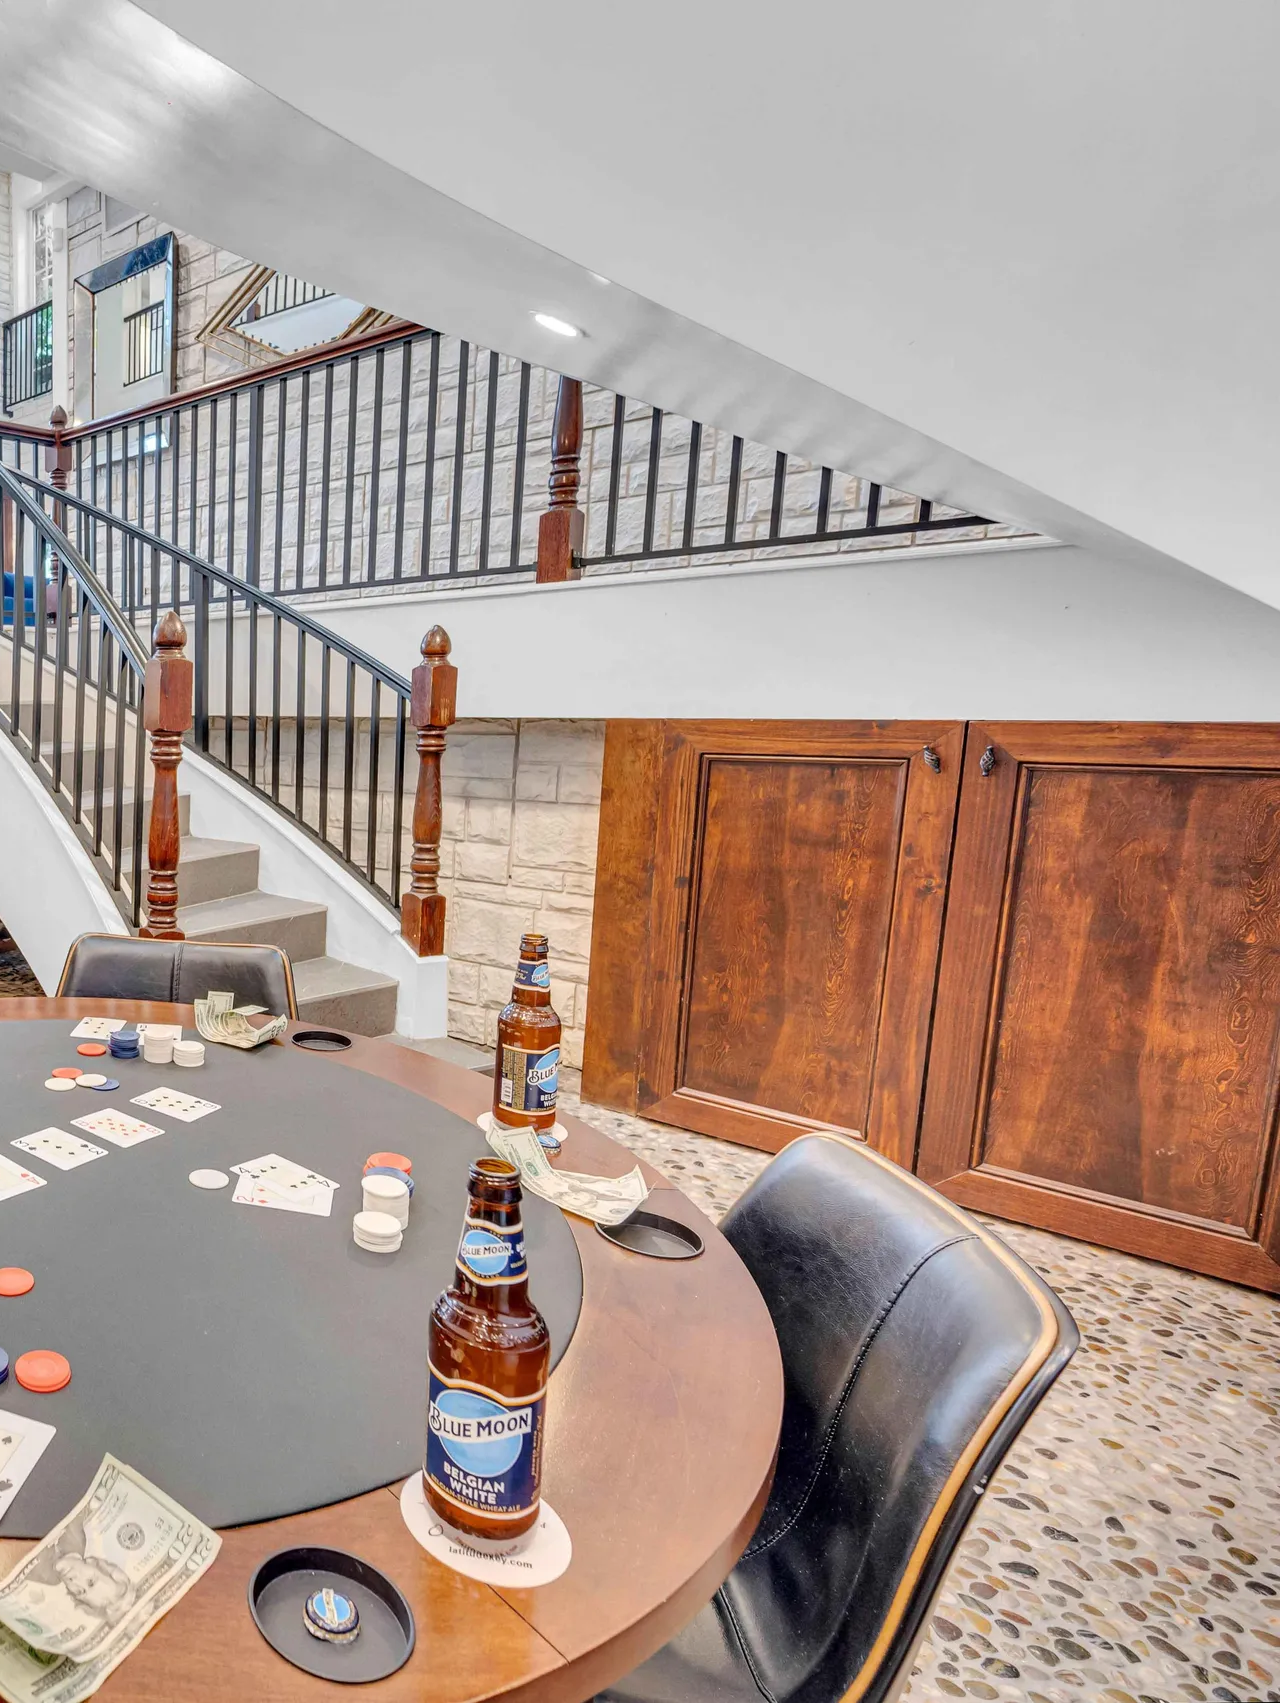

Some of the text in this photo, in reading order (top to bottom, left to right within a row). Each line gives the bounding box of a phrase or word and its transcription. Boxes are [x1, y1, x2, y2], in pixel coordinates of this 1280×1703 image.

[529, 1067, 554, 1083] BLUE
[238, 1166, 251, 1174] 4
[25, 1176, 40, 1185] A
[316, 1179, 331, 1188] 4
[236, 1195, 254, 1203] 2
[462, 1245, 510, 1256] BLUE MOON
[430, 1406, 529, 1438] BLUE MOON
[443, 1461, 505, 1494] BELGIAN
[449, 1476, 497, 1505] WHITE
[480, 1503, 507, 1513] WHEAT
[168, 1520, 193, 1560] 20
[185, 1532, 213, 1571] 20
